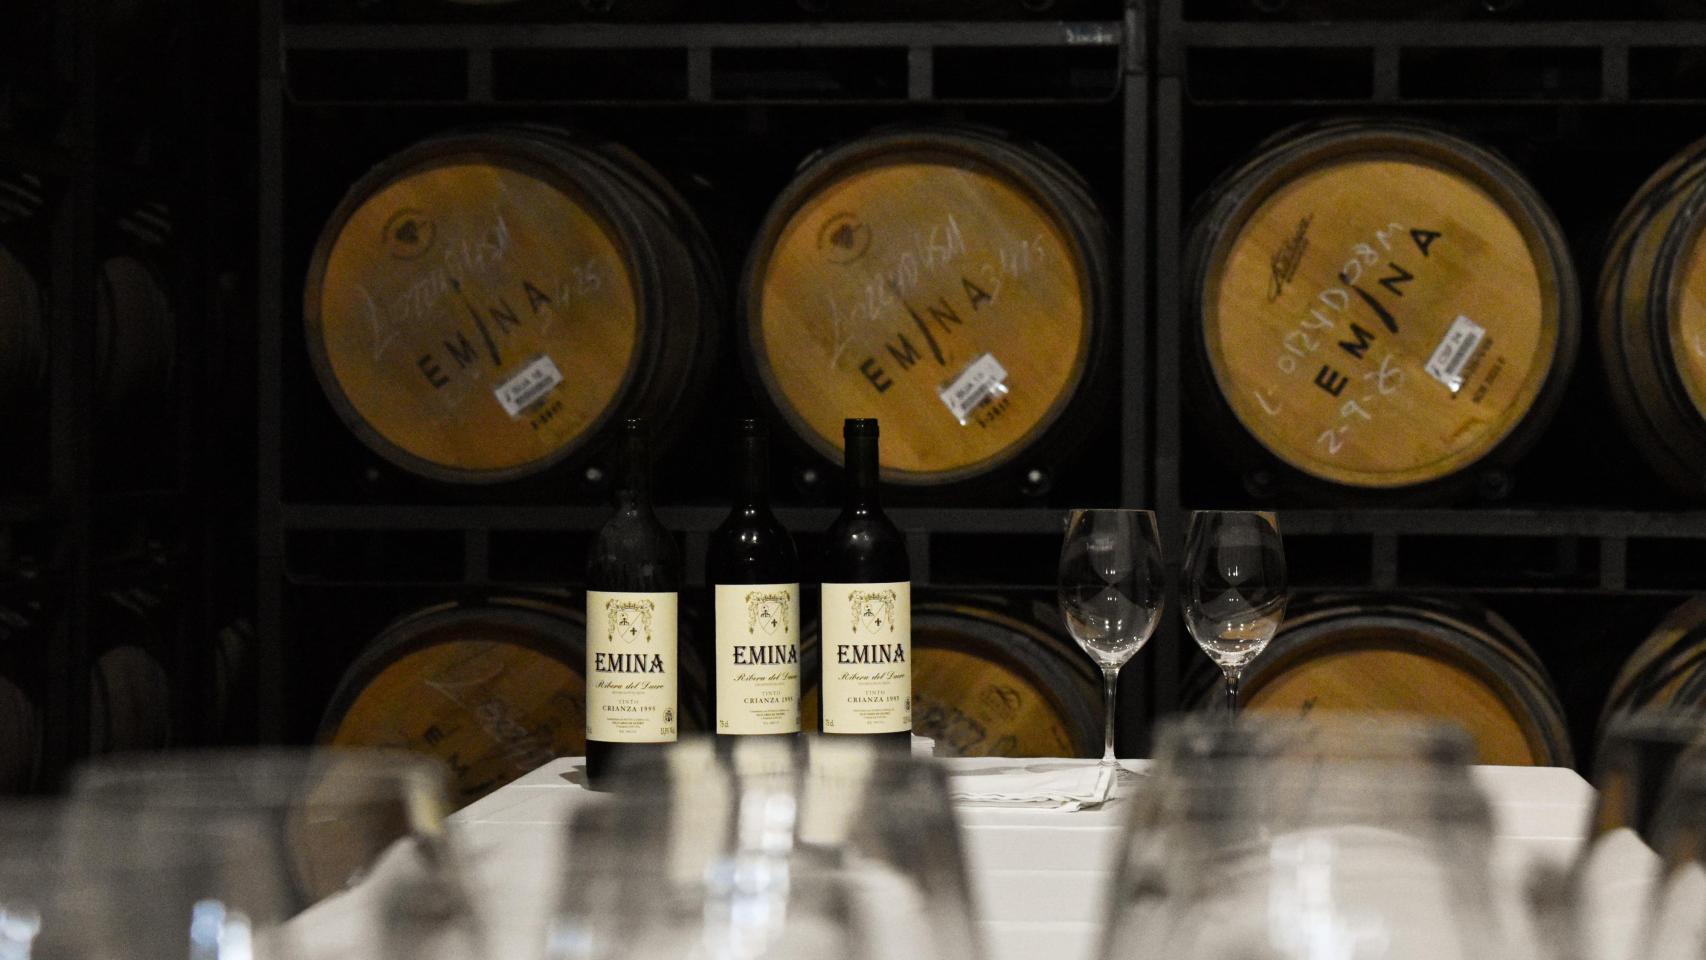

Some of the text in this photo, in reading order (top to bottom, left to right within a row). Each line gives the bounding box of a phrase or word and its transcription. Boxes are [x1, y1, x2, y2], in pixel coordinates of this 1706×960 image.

[1314, 227, 1442, 398] EMINA
[416, 278, 553, 390] EMINA
[858, 276, 992, 395] EMINA
[595, 652, 666, 674] EMINA
[732, 644, 798, 666] EMINA
[836, 643, 906, 665] EMINA
[595, 680, 624, 689] Ribera
[625, 681, 638, 689] del
[733, 672, 766, 681] Ribera
[768, 673, 780, 681] del
[838, 671, 869, 681] Ribera
[871, 672, 886, 681] del
[602, 705, 637, 713] CRIANZA
[743, 696, 780, 704] CRIANZA
